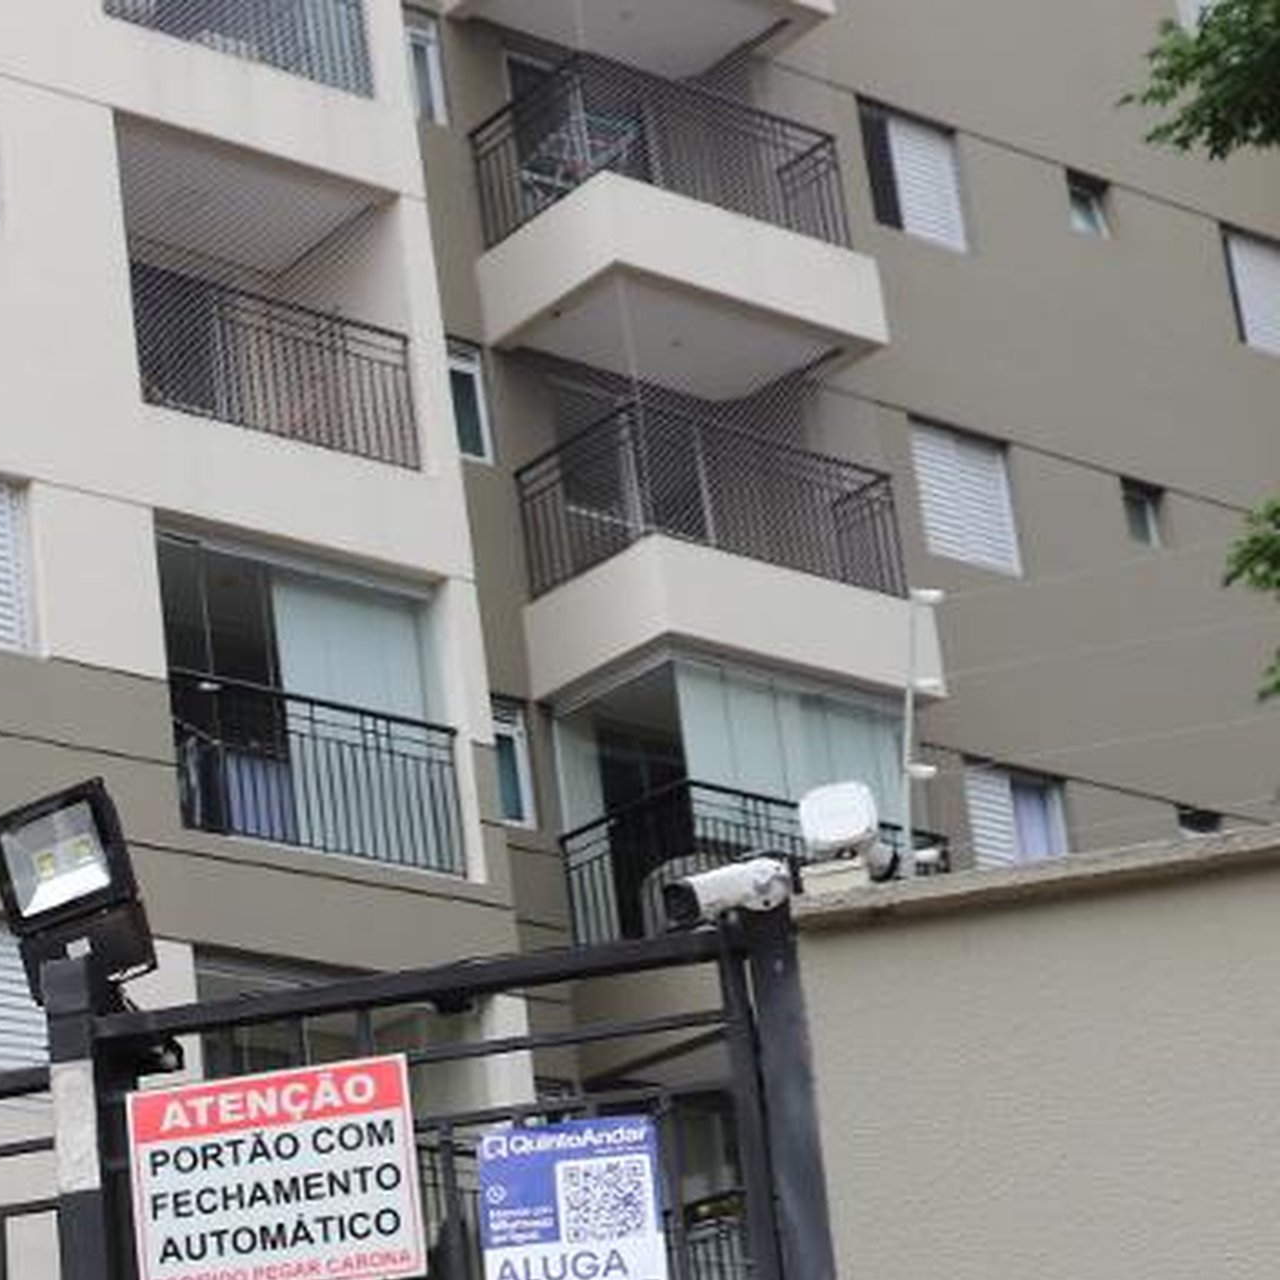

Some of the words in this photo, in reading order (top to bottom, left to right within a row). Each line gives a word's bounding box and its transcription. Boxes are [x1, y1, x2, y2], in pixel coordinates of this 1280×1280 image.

[161, 1073, 374, 1130] ATENÇÃO
[149, 1131, 300, 1176] PORTÃO
[312, 1120, 395, 1155] COM
[509, 1128, 646, 1154] QuintoAndar
[151, 1162, 402, 1220] FECHAMENTO
[159, 1208, 401, 1264] AUTOMÁTICO
[252, 1259, 322, 1280] PEGAR
[326, 1249, 411, 1273] CARONA
